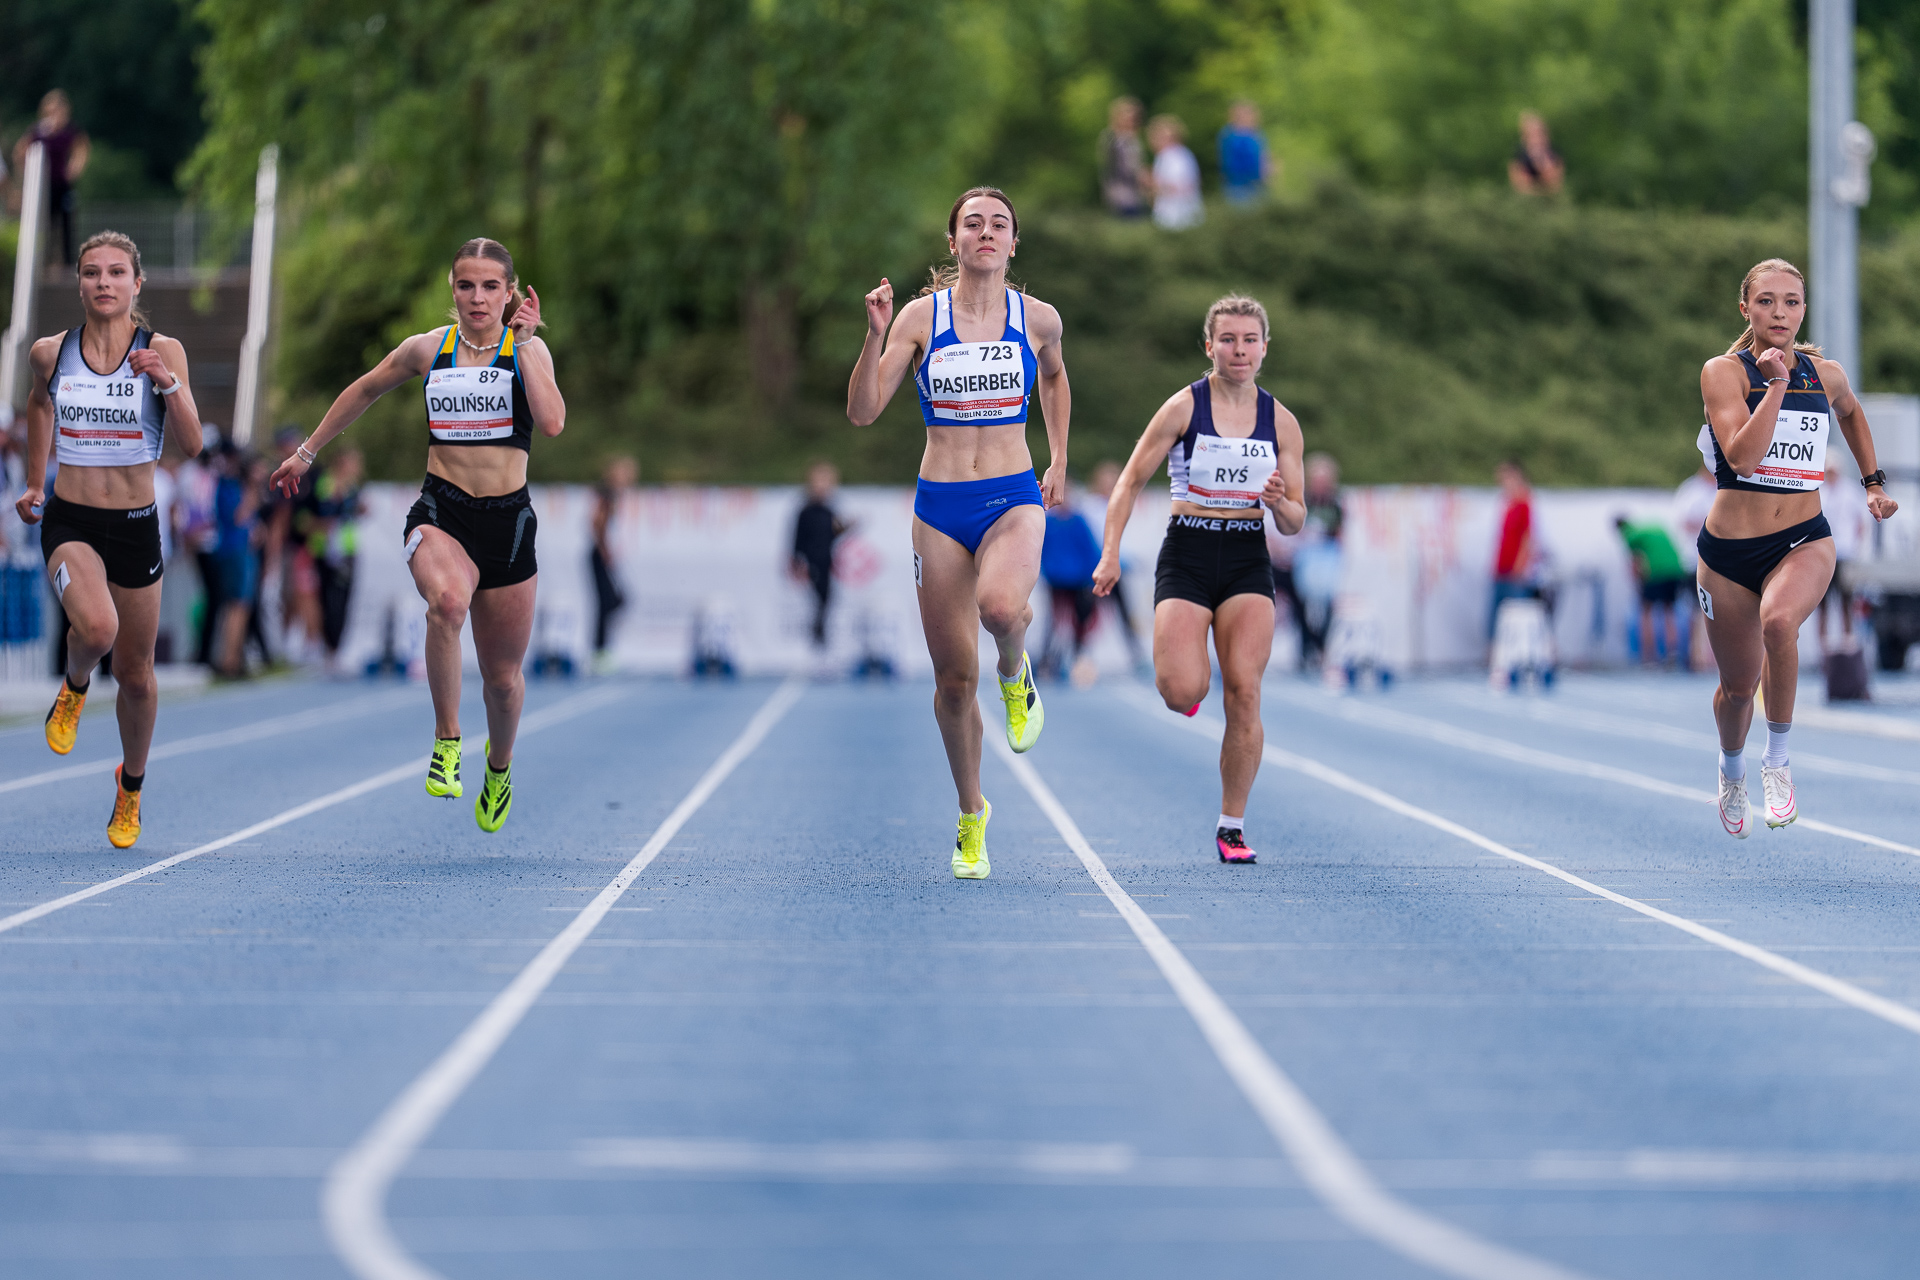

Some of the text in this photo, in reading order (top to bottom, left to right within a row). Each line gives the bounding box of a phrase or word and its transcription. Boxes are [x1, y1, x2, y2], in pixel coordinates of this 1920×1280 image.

[979, 345, 1013, 361] 723
[479, 370, 499, 384] 89
[932, 371, 1021, 394] PASIERBEK
[106, 382, 134, 397] 118
[430, 392, 508, 413] DOLIŃSKA
[60, 405, 137, 424] KOPYSTECKA
[955, 409, 1003, 419] LUBLIN 2026
[1800, 416, 1819, 432] 53
[1241, 443, 1269, 457] 161
[1764, 441, 1814, 462] ATOŃ
[1214, 465, 1249, 483] RYŚ
[1759, 476, 1804, 487] LUBLIN 2026
[437, 484, 527, 510] NIKE PRO
[127, 508, 151, 519] NIKE
[1176, 514, 1262, 531] NIKE PRO
[914, 552, 919, 580] 5
[1699, 587, 1708, 613] 3
